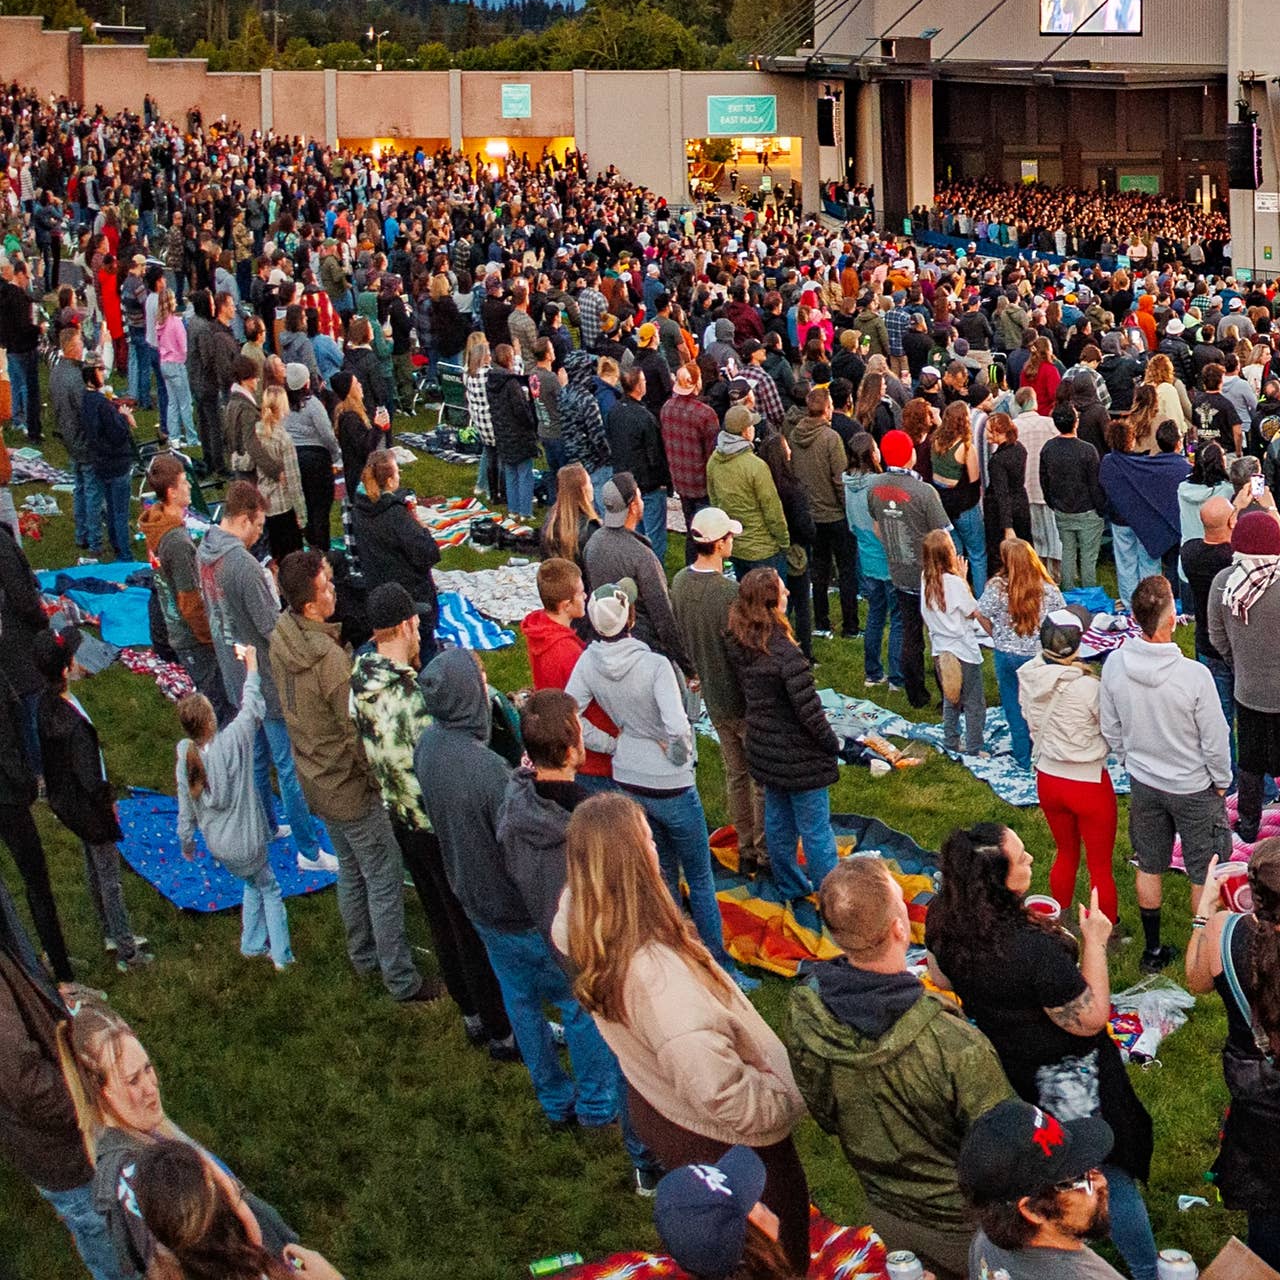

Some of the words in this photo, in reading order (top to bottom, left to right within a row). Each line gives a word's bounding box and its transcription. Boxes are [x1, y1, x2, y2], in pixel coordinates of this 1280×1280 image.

[727, 104, 743, 113] EXIT
[745, 104, 756, 113] TO
[720, 115, 739, 125] EAST
[740, 115, 764, 125] PLAZA
